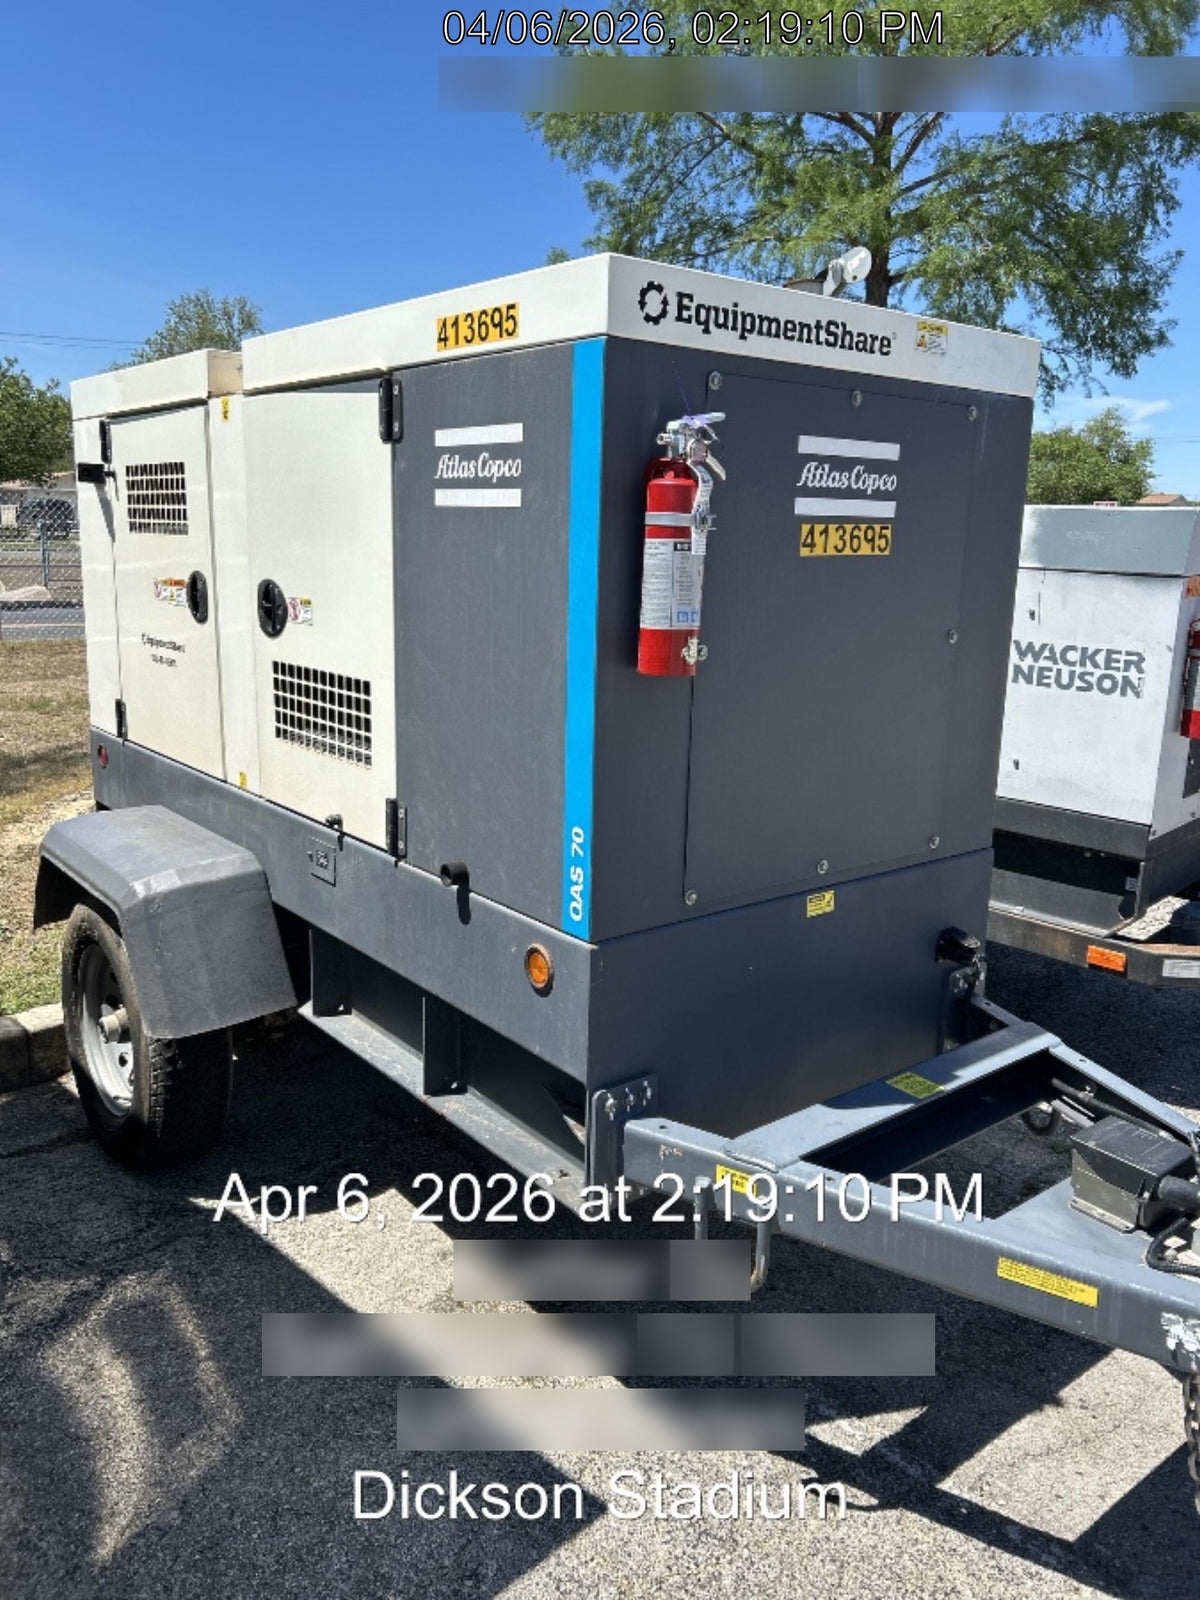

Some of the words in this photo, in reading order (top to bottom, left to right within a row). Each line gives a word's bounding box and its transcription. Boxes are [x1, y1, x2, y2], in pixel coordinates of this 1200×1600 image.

[437, 303, 517, 348] 413695
[674, 290, 893, 356] EquipmentShare
[435, 453, 477, 479] Atlas
[477, 452, 522, 483] Copco
[797, 461, 849, 490] Atlas
[850, 464, 898, 495] Copco
[800, 524, 890, 555] 413695
[1012, 639, 1146, 674] WACKER
[1010, 662, 1143, 699] NEUSON
[571, 826, 585, 858] 70
